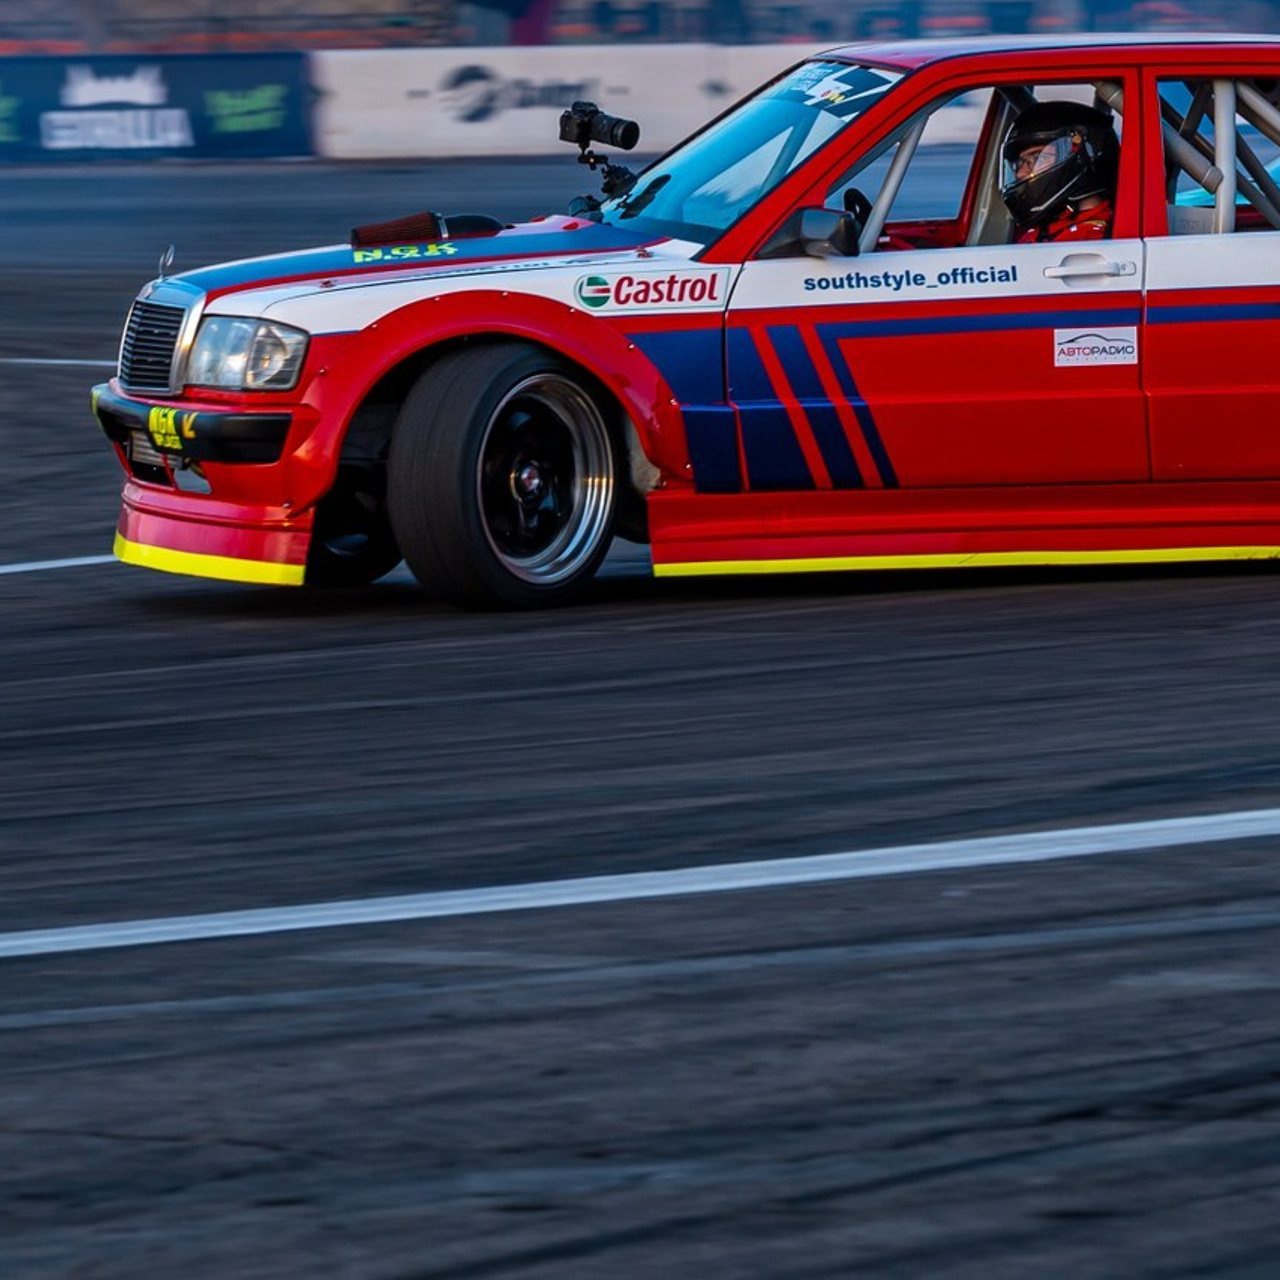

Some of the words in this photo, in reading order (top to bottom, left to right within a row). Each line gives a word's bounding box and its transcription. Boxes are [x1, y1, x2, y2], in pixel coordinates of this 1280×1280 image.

[614, 273, 718, 305] Castrol
[803, 265, 1018, 291] southstyle_official
[1057, 345, 1136, 357] АВТОРАДИО
